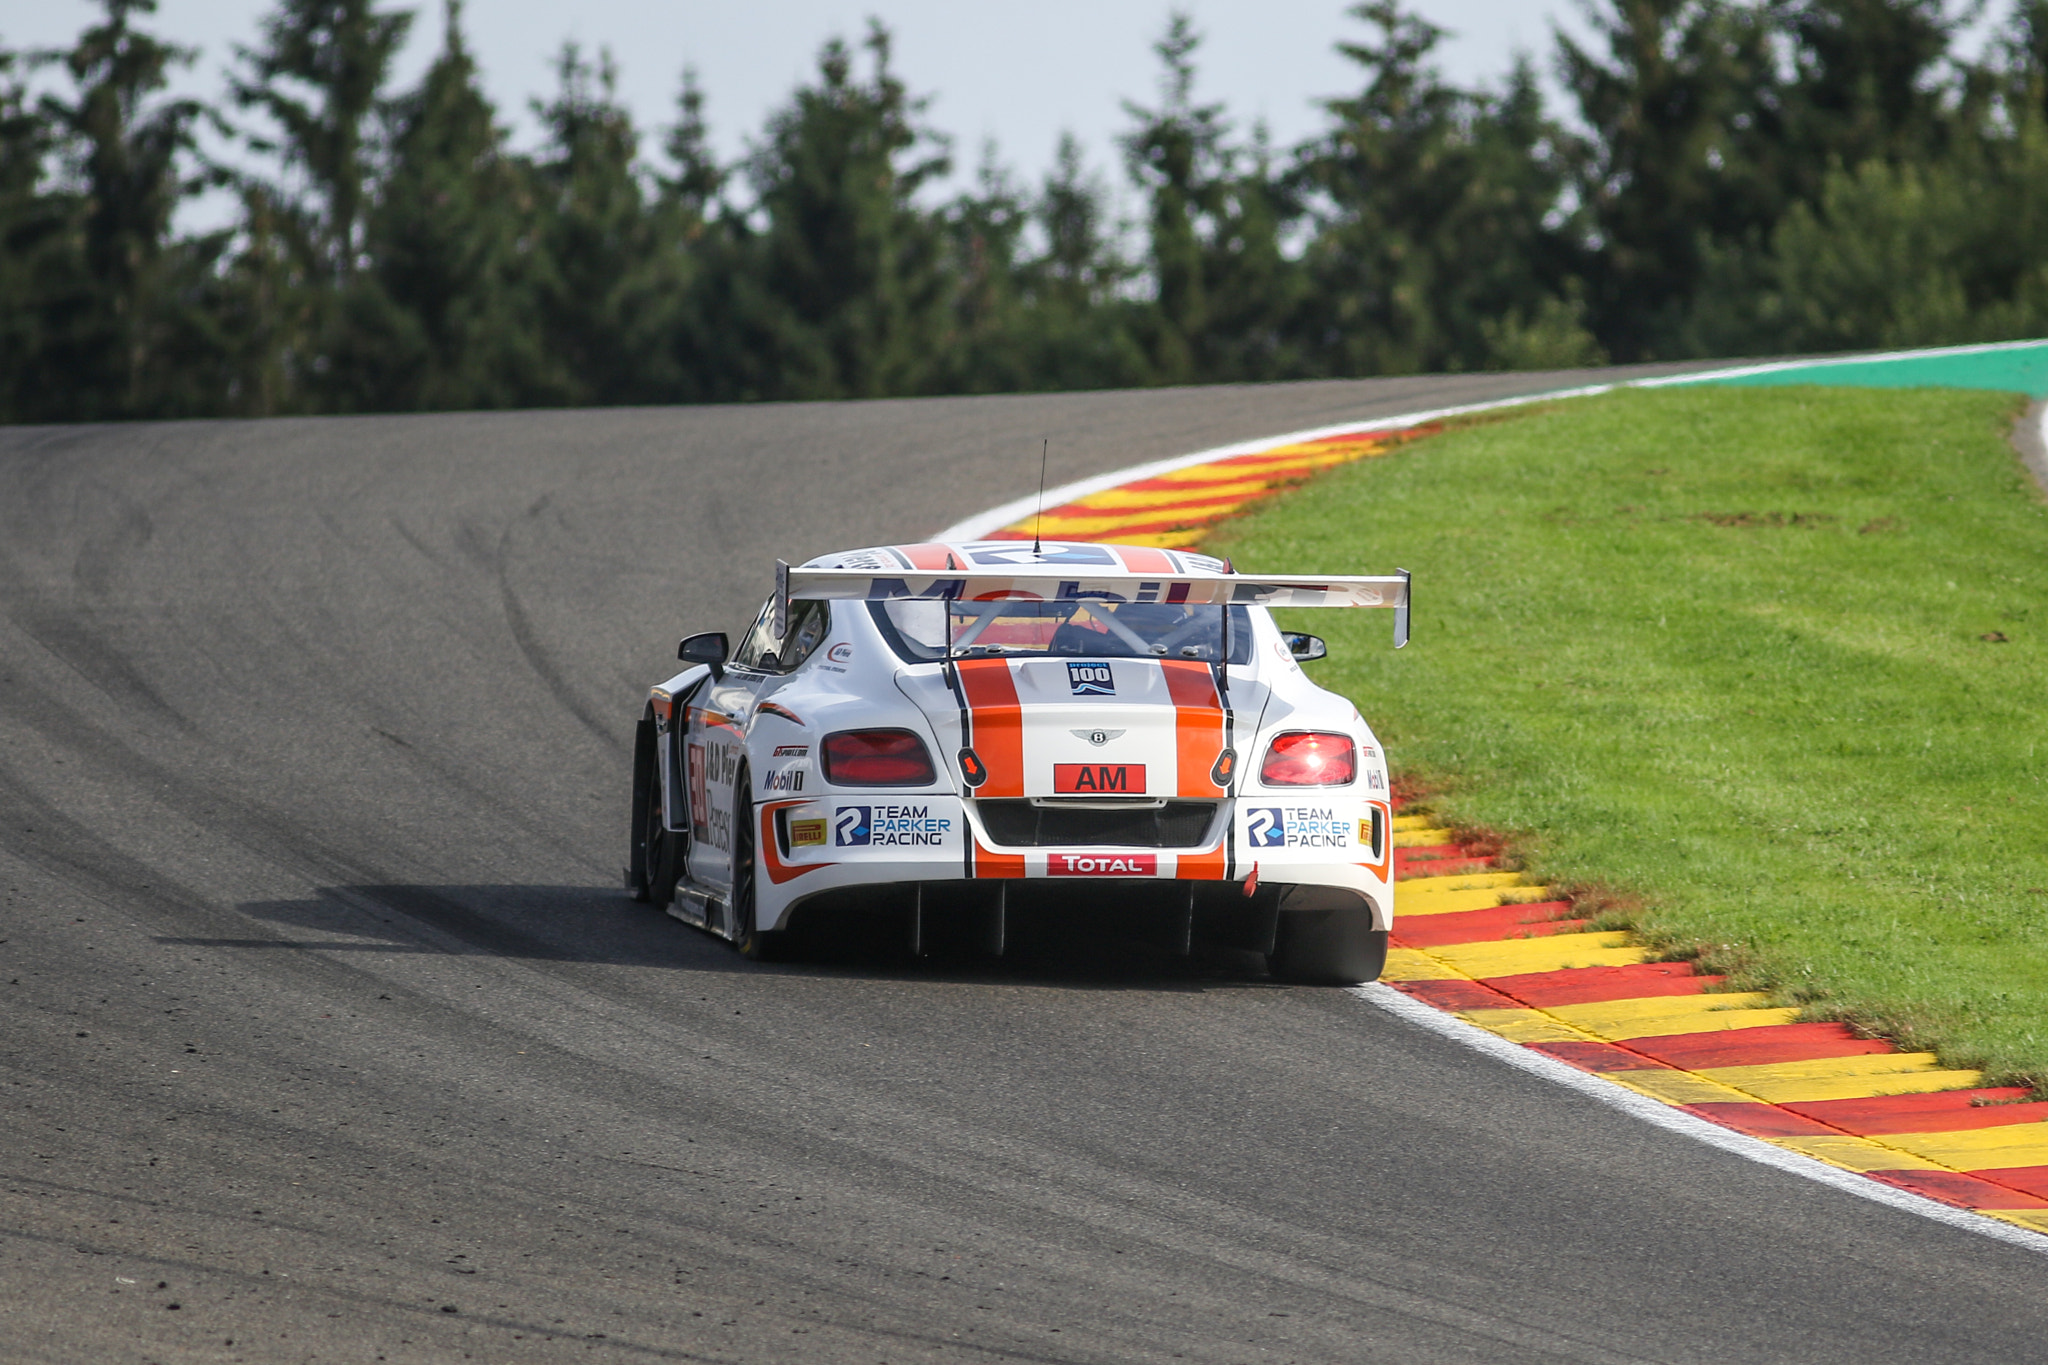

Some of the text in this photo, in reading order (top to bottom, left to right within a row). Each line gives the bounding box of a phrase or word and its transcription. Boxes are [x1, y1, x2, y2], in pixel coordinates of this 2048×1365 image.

[1070, 667, 1110, 682] 100
[764, 770, 793, 791] Mobil
[1075, 766, 1127, 790] AM
[874, 806, 928, 819] TEAM
[1285, 808, 1333, 821] TEAM
[873, 819, 951, 832] PARKER
[1286, 821, 1351, 835] PARKER
[792, 824, 822, 842] PIRELLI
[873, 832, 942, 846] RACING
[1061, 855, 1143, 872] TOTAL
